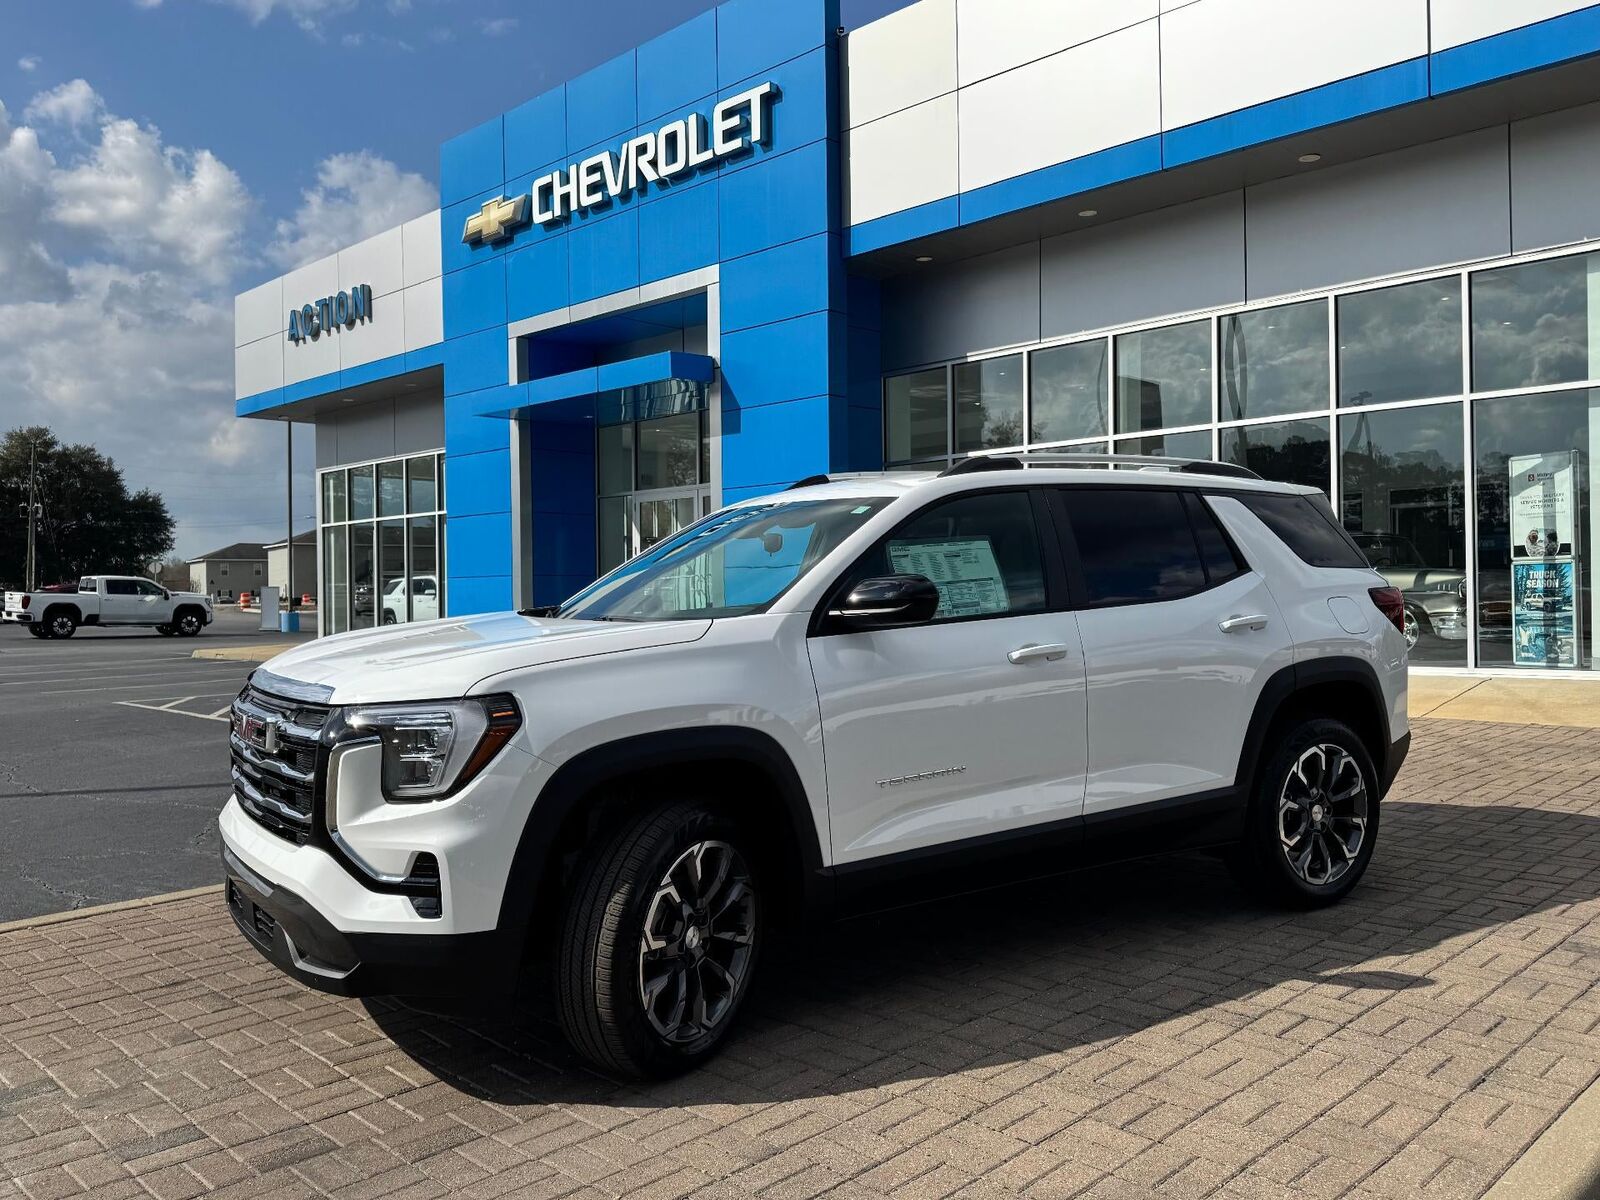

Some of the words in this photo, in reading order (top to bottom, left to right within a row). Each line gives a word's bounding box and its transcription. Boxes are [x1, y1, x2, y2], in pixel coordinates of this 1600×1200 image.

[532, 81, 777, 225] CHEVROLET
[288, 284, 371, 344] ACTION
[1526, 578, 1559, 589] SEASON
[1529, 570, 1556, 580] TRUCK
